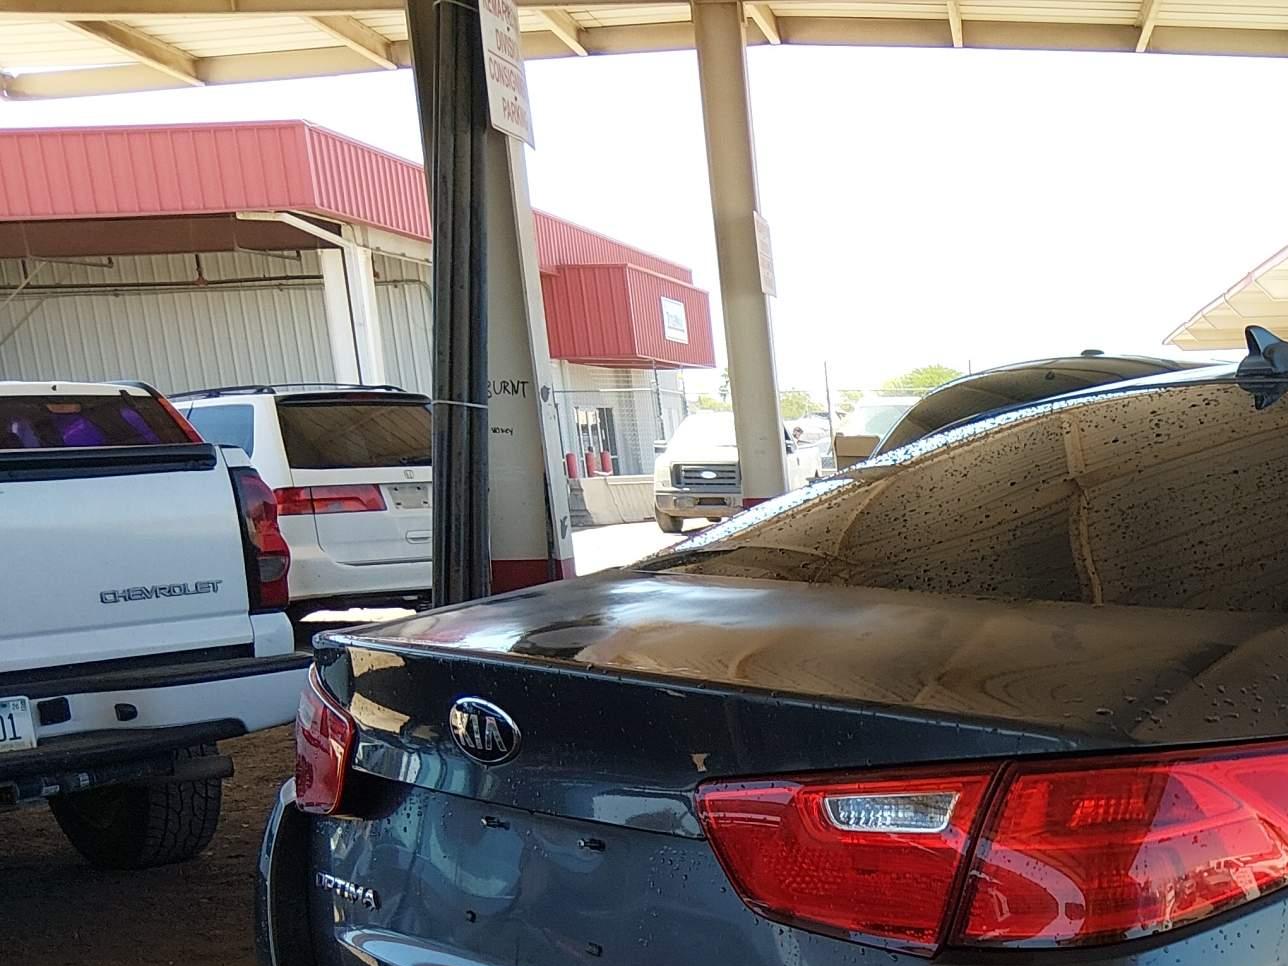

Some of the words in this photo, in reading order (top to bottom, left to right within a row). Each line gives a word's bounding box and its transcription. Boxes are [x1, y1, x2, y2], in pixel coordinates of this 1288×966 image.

[100, 580, 223, 604] CHEVROLET
[451, 710, 508, 752] KIA
[315, 872, 378, 911] OPTIMA
